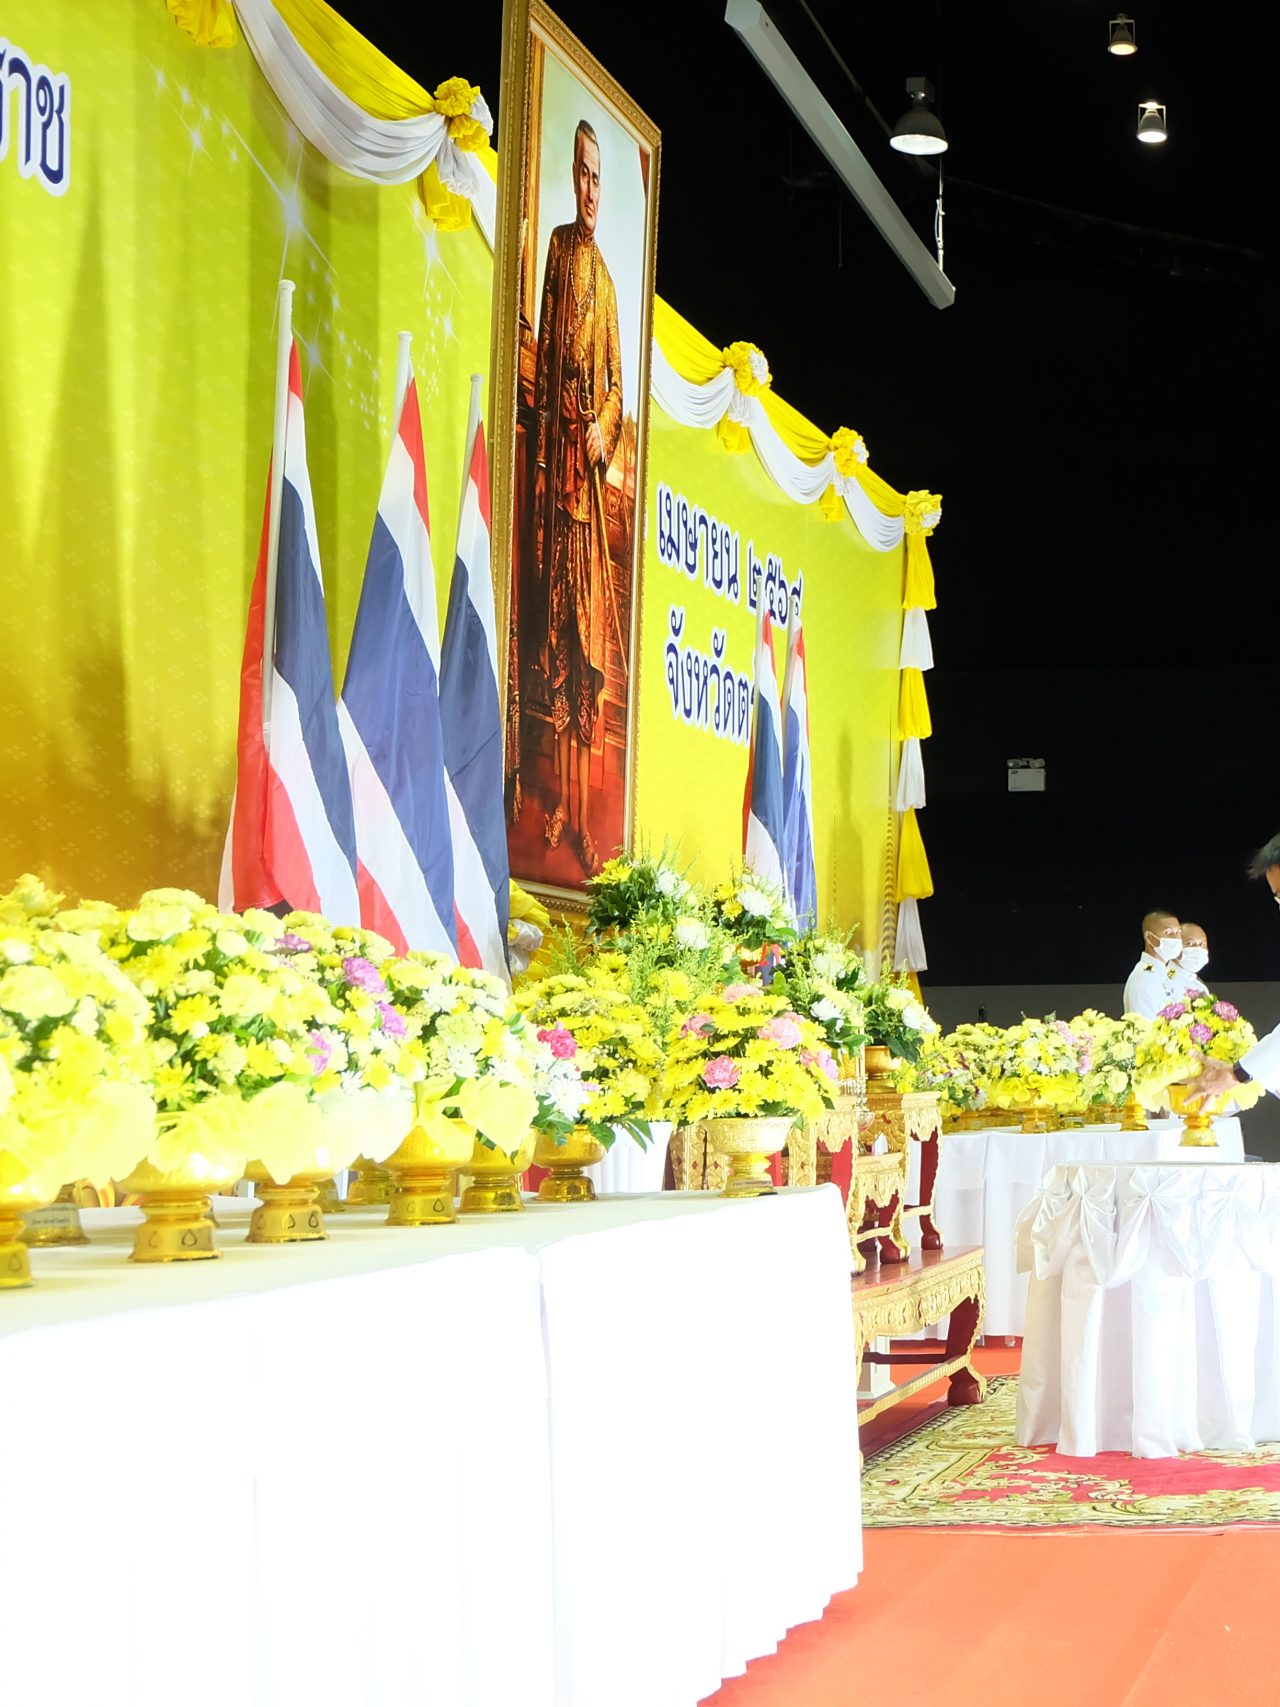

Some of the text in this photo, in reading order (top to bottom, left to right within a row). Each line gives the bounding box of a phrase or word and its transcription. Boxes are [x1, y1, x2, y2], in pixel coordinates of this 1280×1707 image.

[0, 47, 65, 185] าช
[659, 487, 739, 600] เมษายน
[666, 609, 755, 741] จังหวัดต
